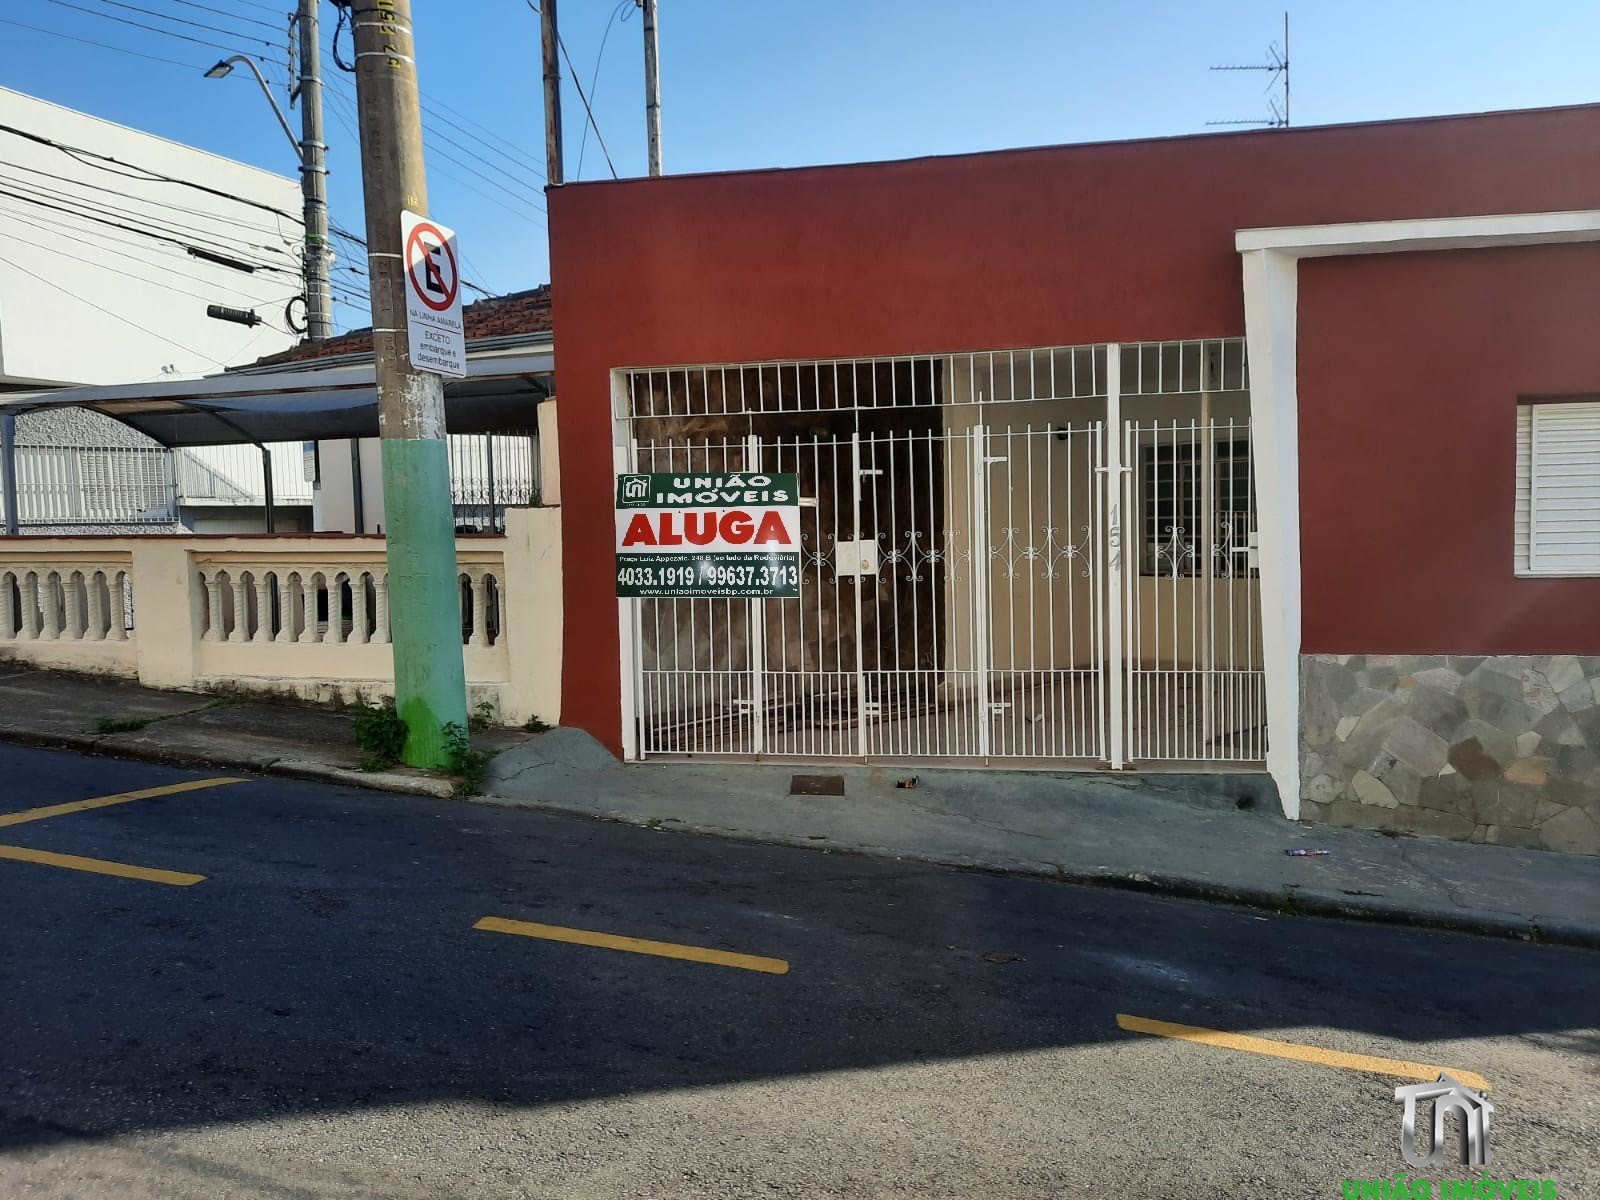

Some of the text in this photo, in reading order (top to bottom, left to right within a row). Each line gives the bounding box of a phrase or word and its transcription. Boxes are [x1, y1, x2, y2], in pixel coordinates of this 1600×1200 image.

[409, 309, 462, 330] NA LINHA AMARELA
[420, 342, 457, 358] embarque e
[417, 352, 460, 370] desembarque
[673, 474, 772, 489] UNIÃO
[656, 487, 789, 504] IMÓVEIS
[621, 510, 793, 547] ALUGA
[1108, 503, 1121, 571] 154
[617, 566, 695, 587] 4033.1919
[706, 565, 798, 586] 99637.3713
[639, 588, 774, 596] www.uniaoimoveisbp.com.br
